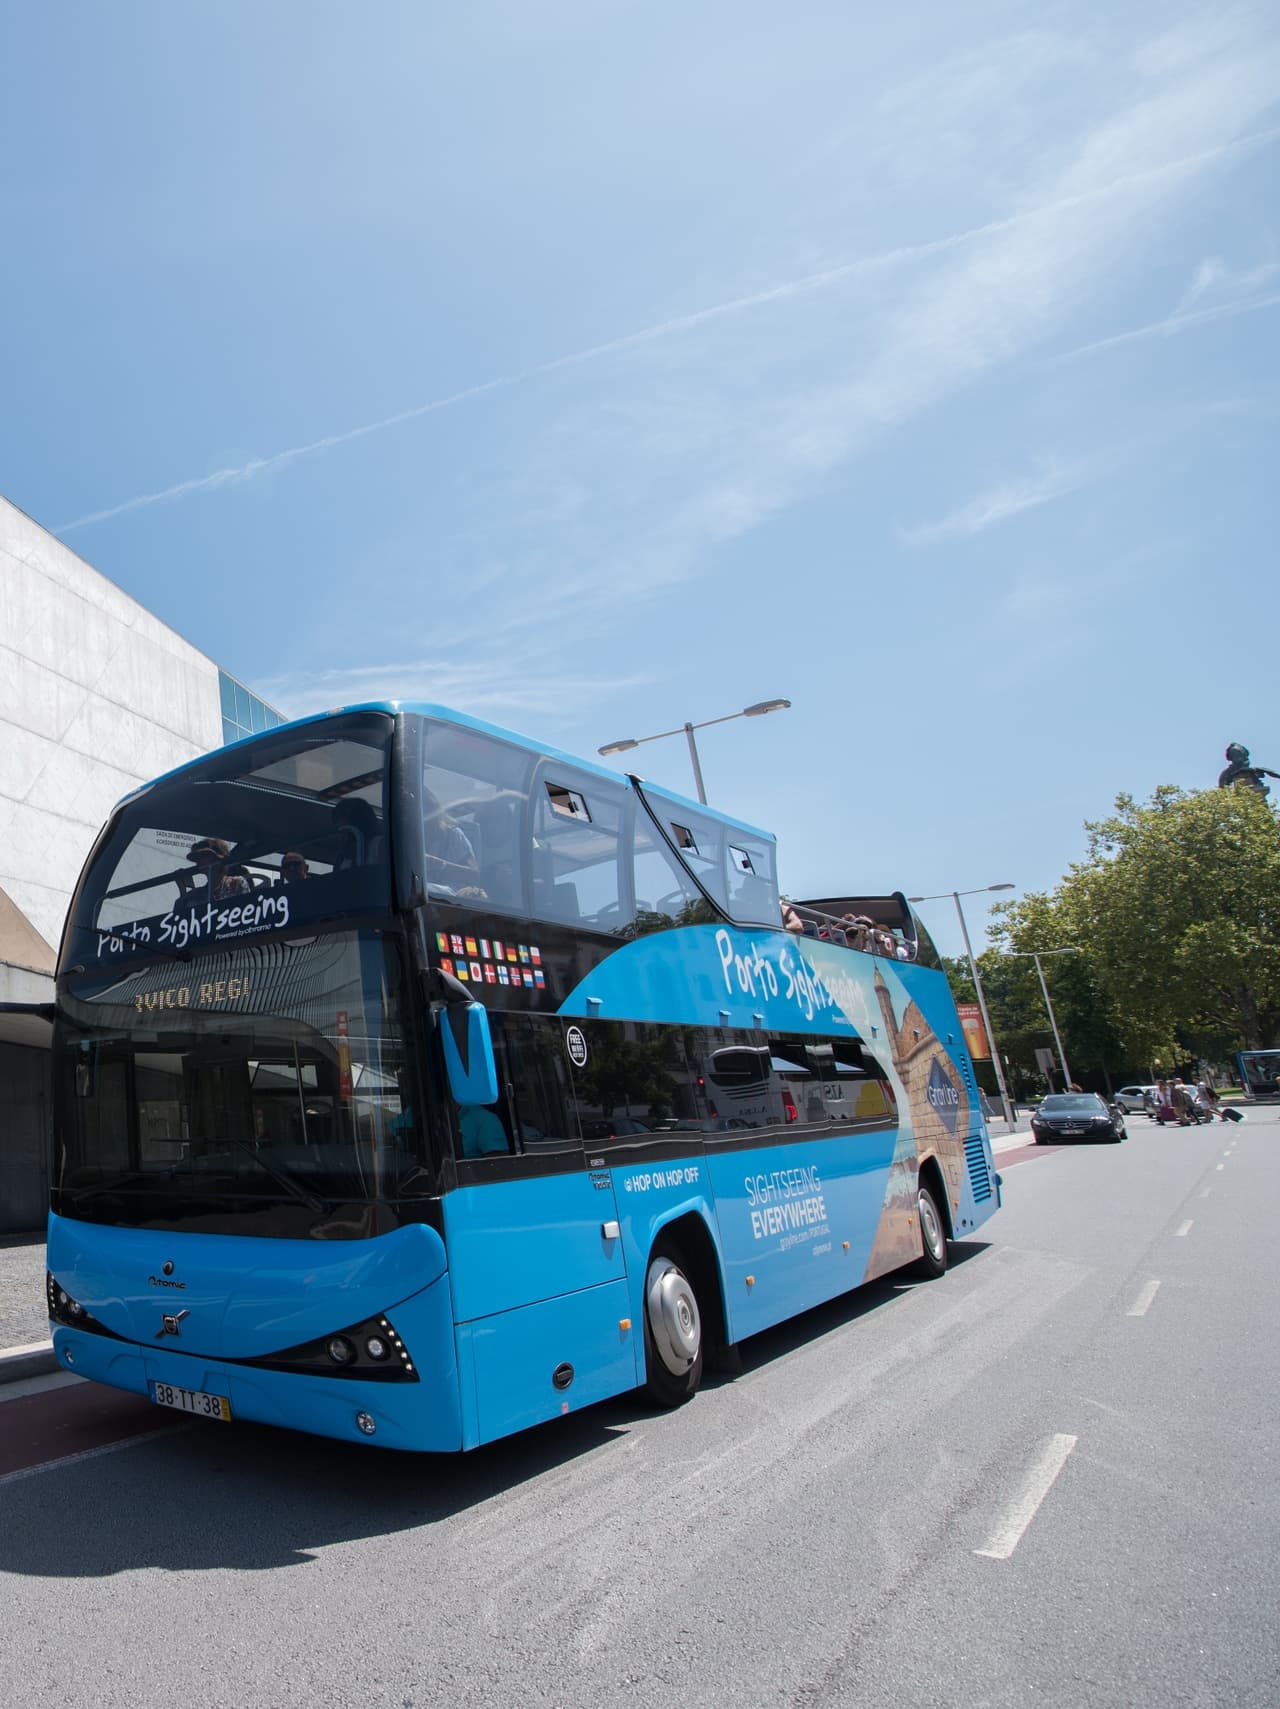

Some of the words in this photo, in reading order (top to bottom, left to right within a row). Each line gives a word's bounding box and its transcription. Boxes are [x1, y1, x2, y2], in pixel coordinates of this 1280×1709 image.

[157, 895, 289, 947] Sightseeing
[715, 929, 778, 1001] Porto
[632, 1174, 651, 1192] HOP
[652, 1172, 666, 1189] ON
[666, 1169, 682, 1187] HOP
[683, 1167, 699, 1184] OFF
[744, 1165, 821, 1207] SIGHTSEEING
[751, 1195, 827, 1239] EVERYWHERE
